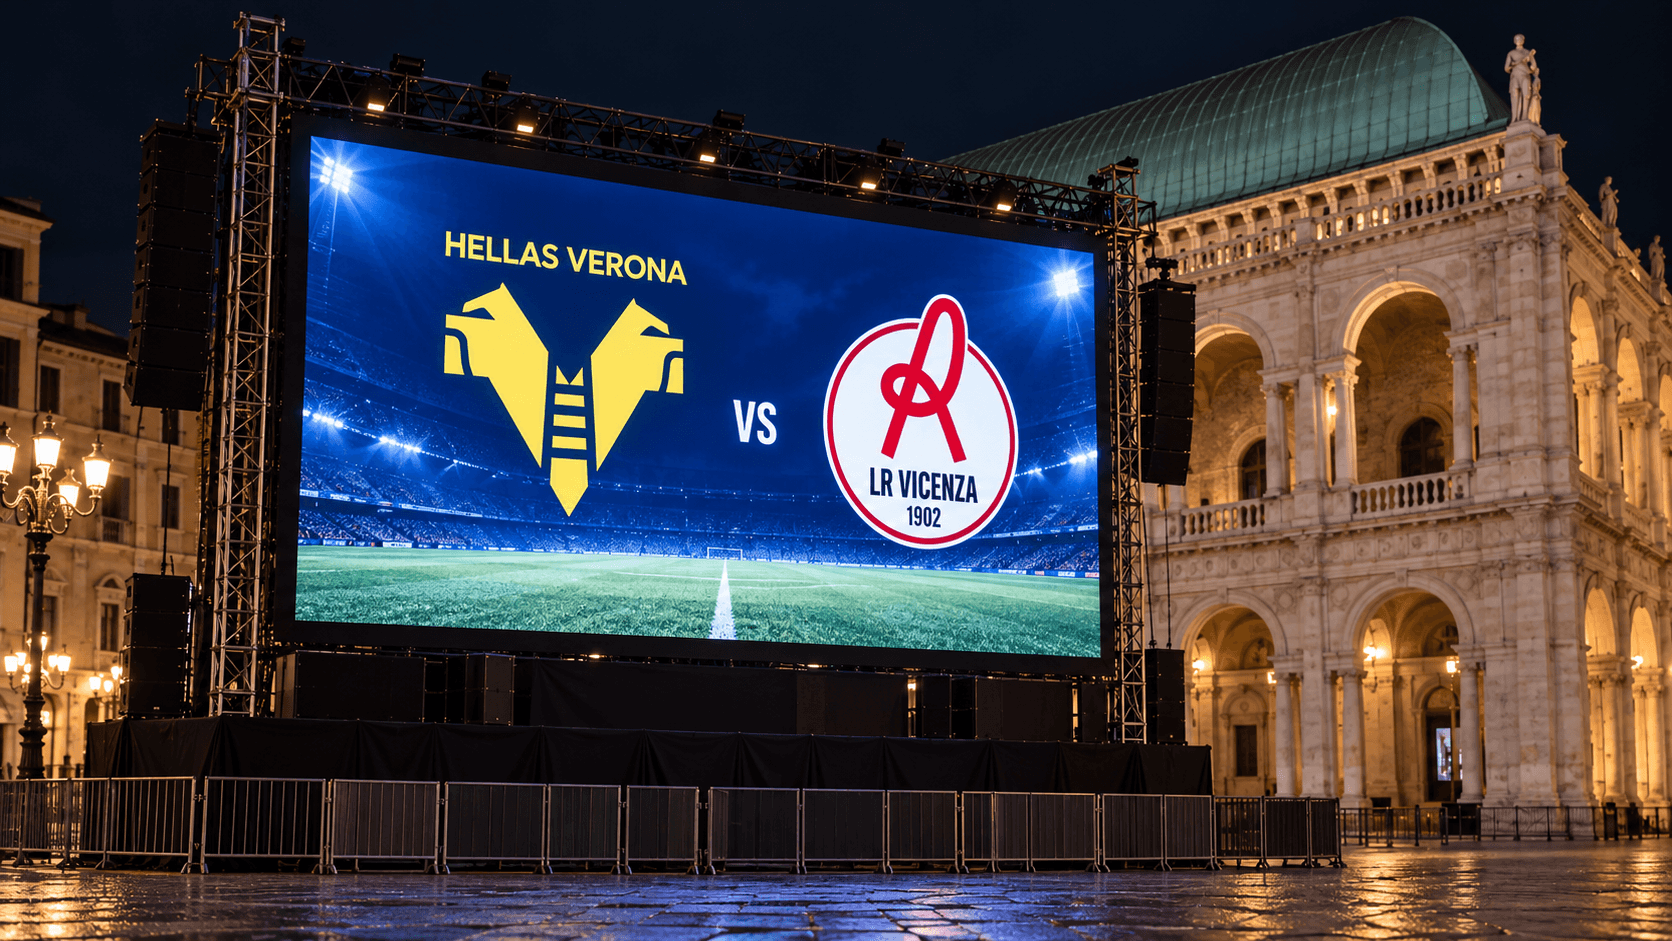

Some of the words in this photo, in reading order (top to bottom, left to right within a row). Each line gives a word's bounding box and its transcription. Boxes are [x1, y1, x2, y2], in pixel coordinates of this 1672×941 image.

[444, 231, 559, 270] HELLAS
[566, 247, 688, 286] VERONA
[732, 399, 777, 446] VS
[869, 467, 893, 497] LR
[898, 469, 979, 504] VICENZA
[906, 505, 942, 528] 1902
